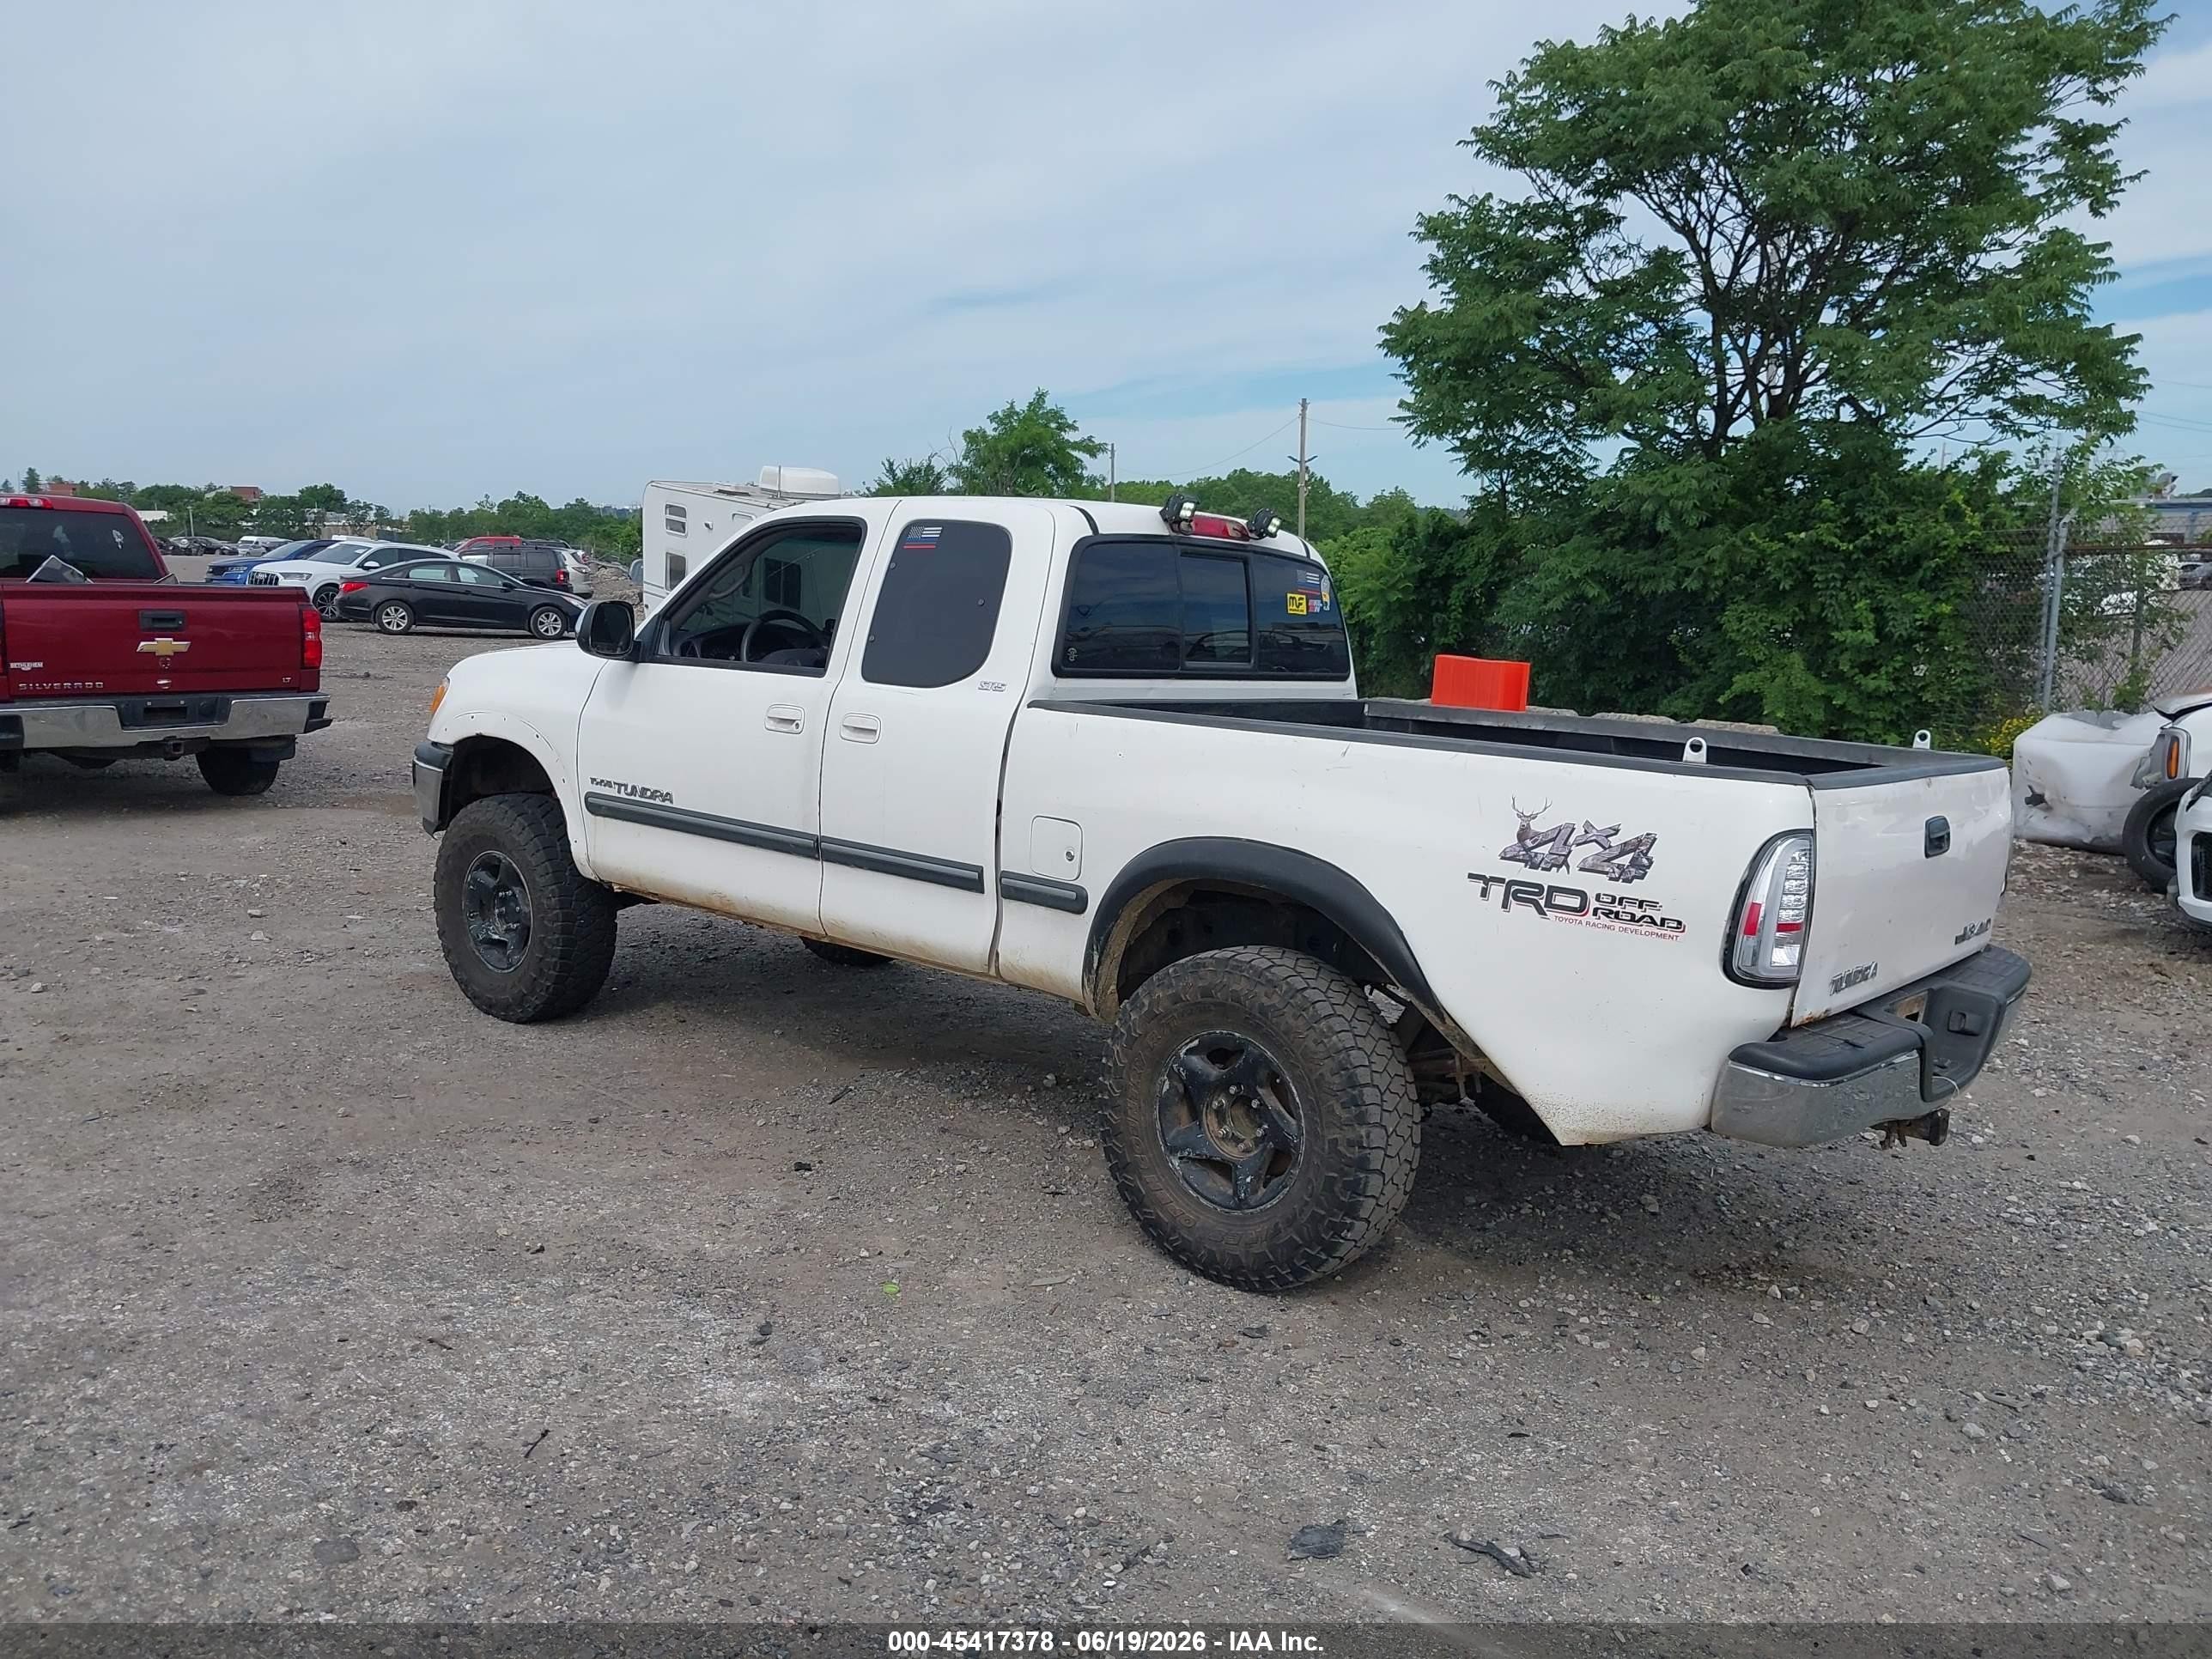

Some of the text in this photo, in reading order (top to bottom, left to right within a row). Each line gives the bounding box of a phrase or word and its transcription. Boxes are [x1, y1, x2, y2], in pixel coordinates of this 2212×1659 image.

[19, 682, 103, 690] SILVERADO
[614, 781, 674, 805] TUNDRA
[1468, 872, 1591, 921] TRD
[1595, 892, 1662, 912] OFF
[1554, 915, 1680, 942] TOYOTA RACING DEVELOPMENT
[1592, 907, 1686, 933] ROAD
